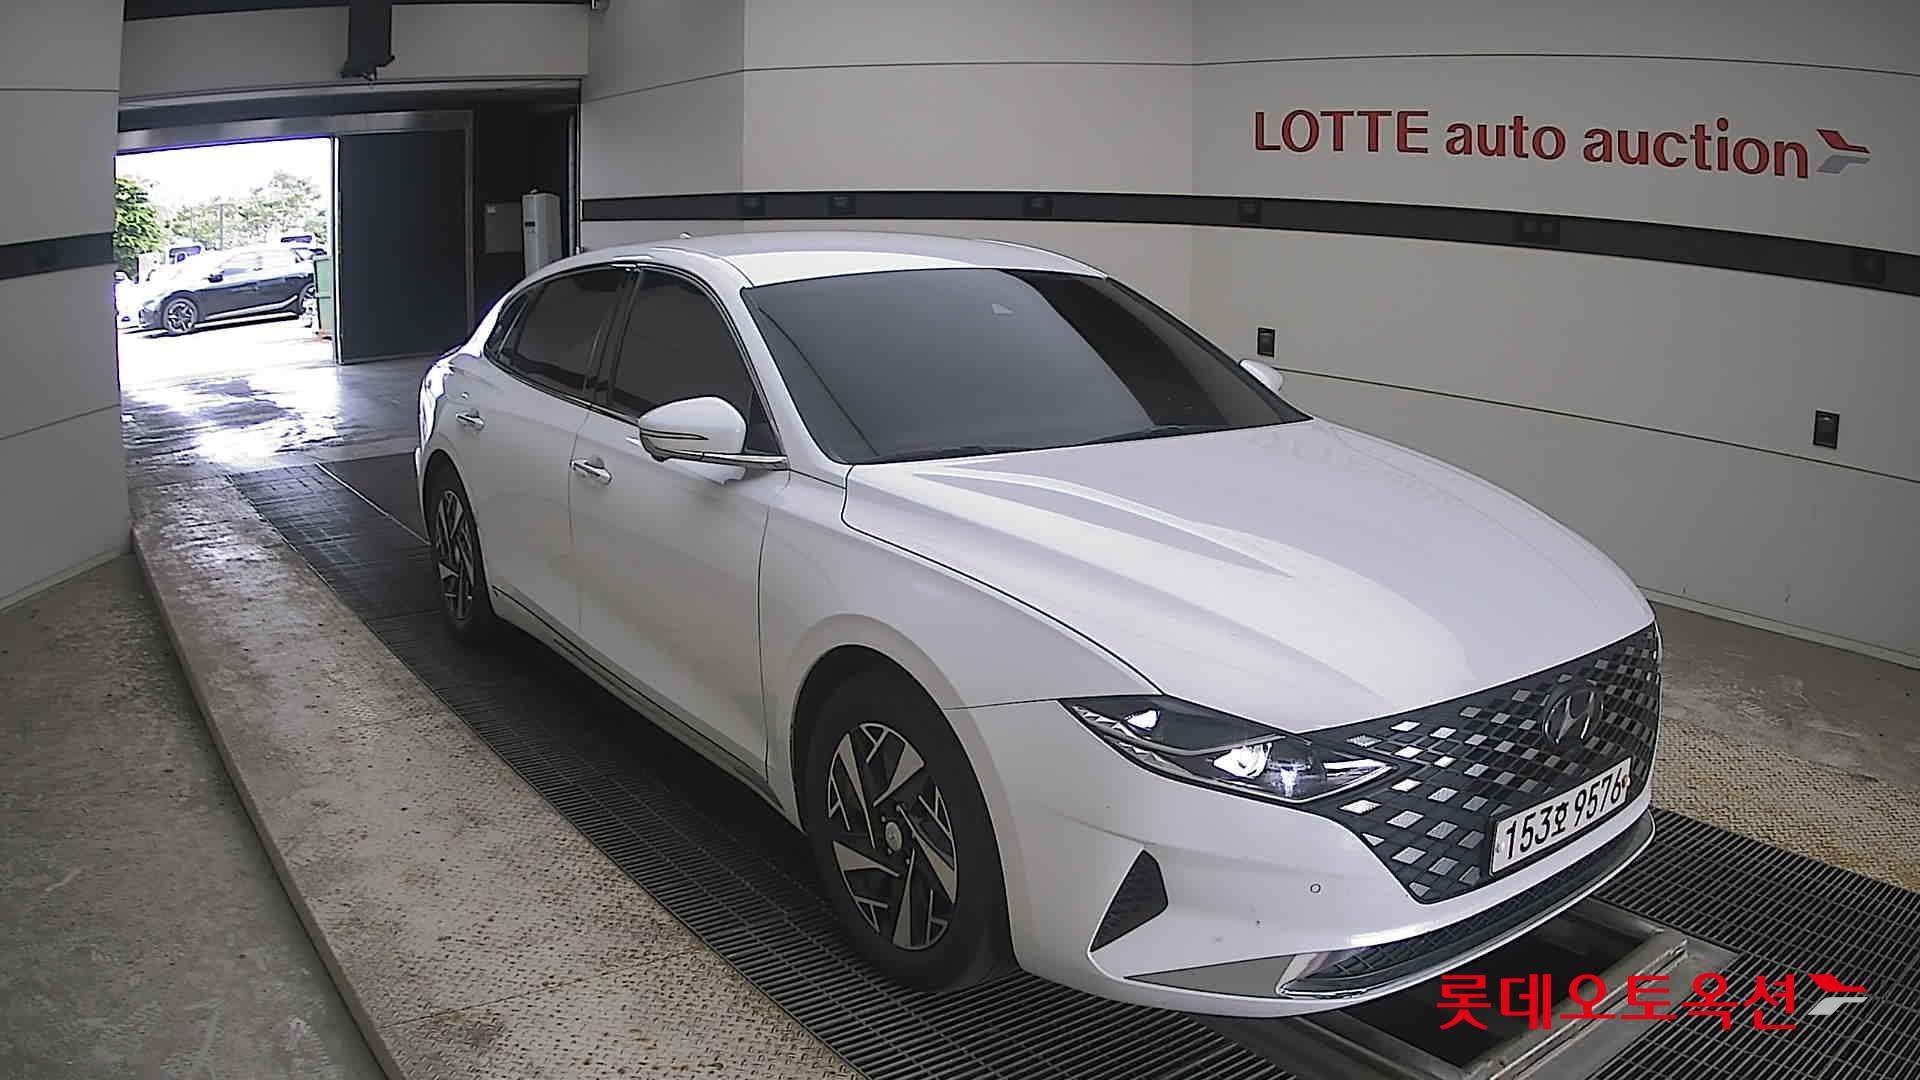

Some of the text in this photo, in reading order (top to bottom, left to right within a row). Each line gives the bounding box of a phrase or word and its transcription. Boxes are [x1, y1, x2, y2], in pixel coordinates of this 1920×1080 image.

[1253, 110, 1810, 180] LOTTE auto auction
[1573, 767, 1623, 828] 9576
